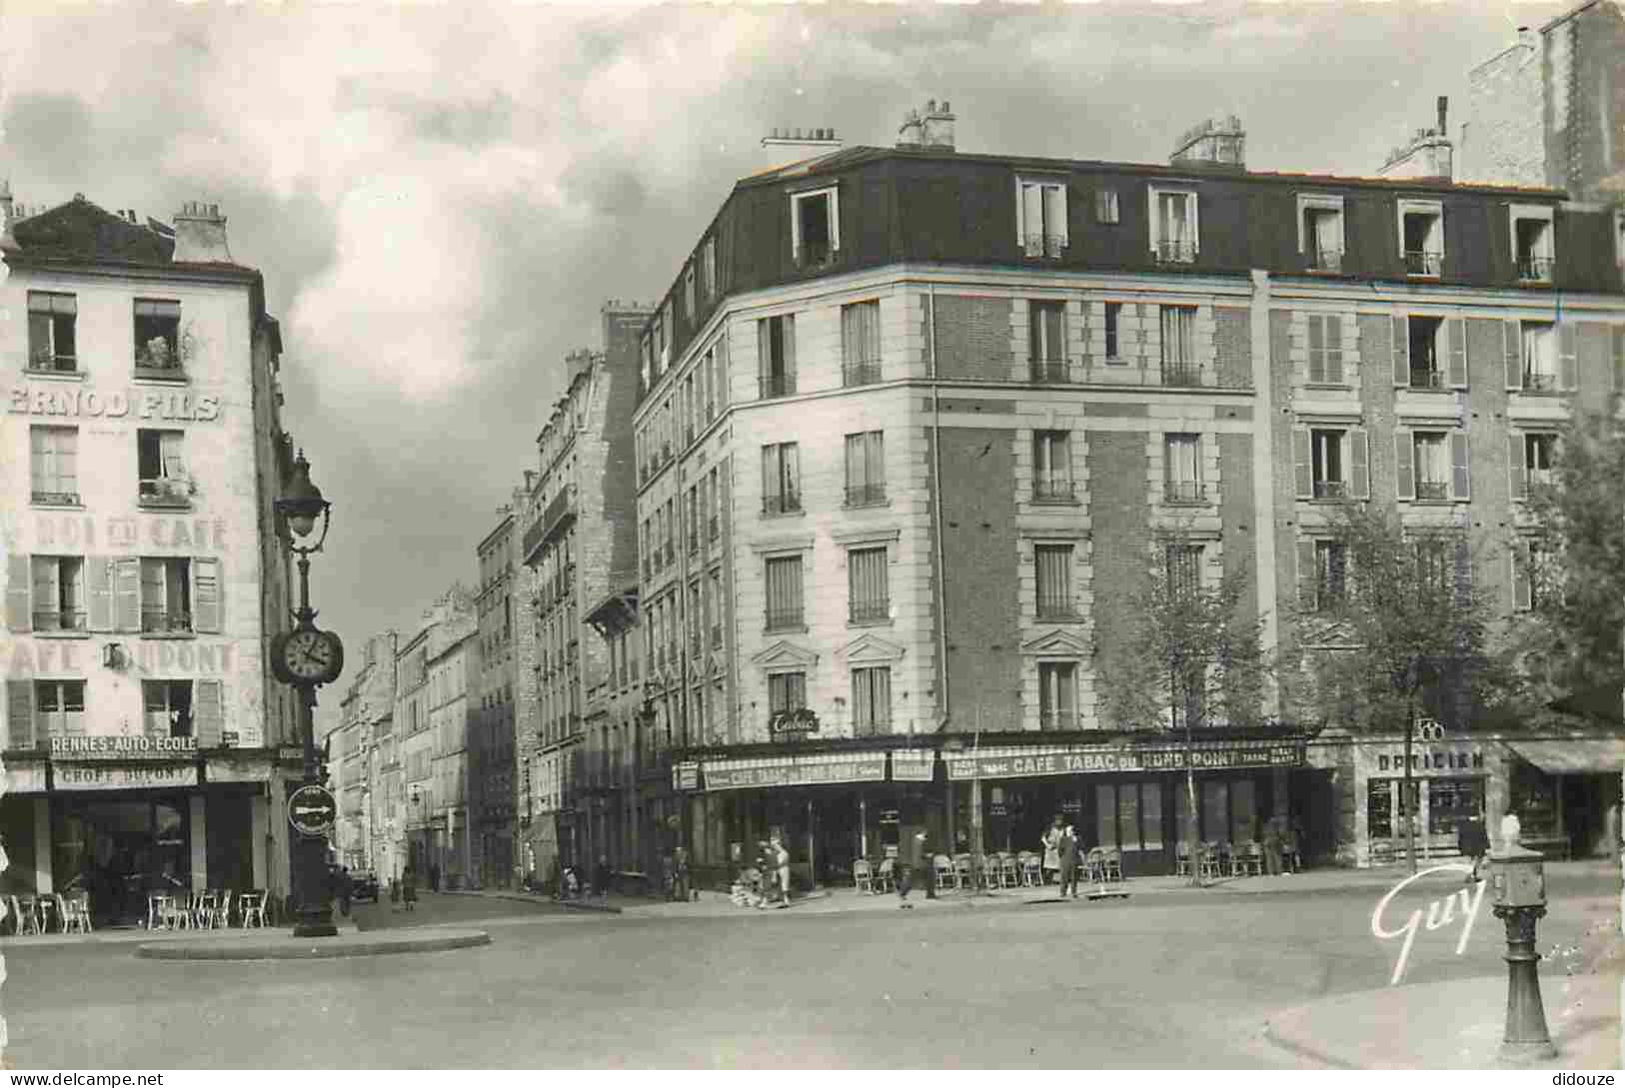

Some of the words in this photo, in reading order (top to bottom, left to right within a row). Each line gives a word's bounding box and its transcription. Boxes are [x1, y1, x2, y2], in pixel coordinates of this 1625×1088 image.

[140, 390, 219, 422] FILS
[774, 713, 813, 732] Tabac
[1063, 754, 1115, 770] TABAC
[1379, 752, 1484, 771] OPTICIEN
